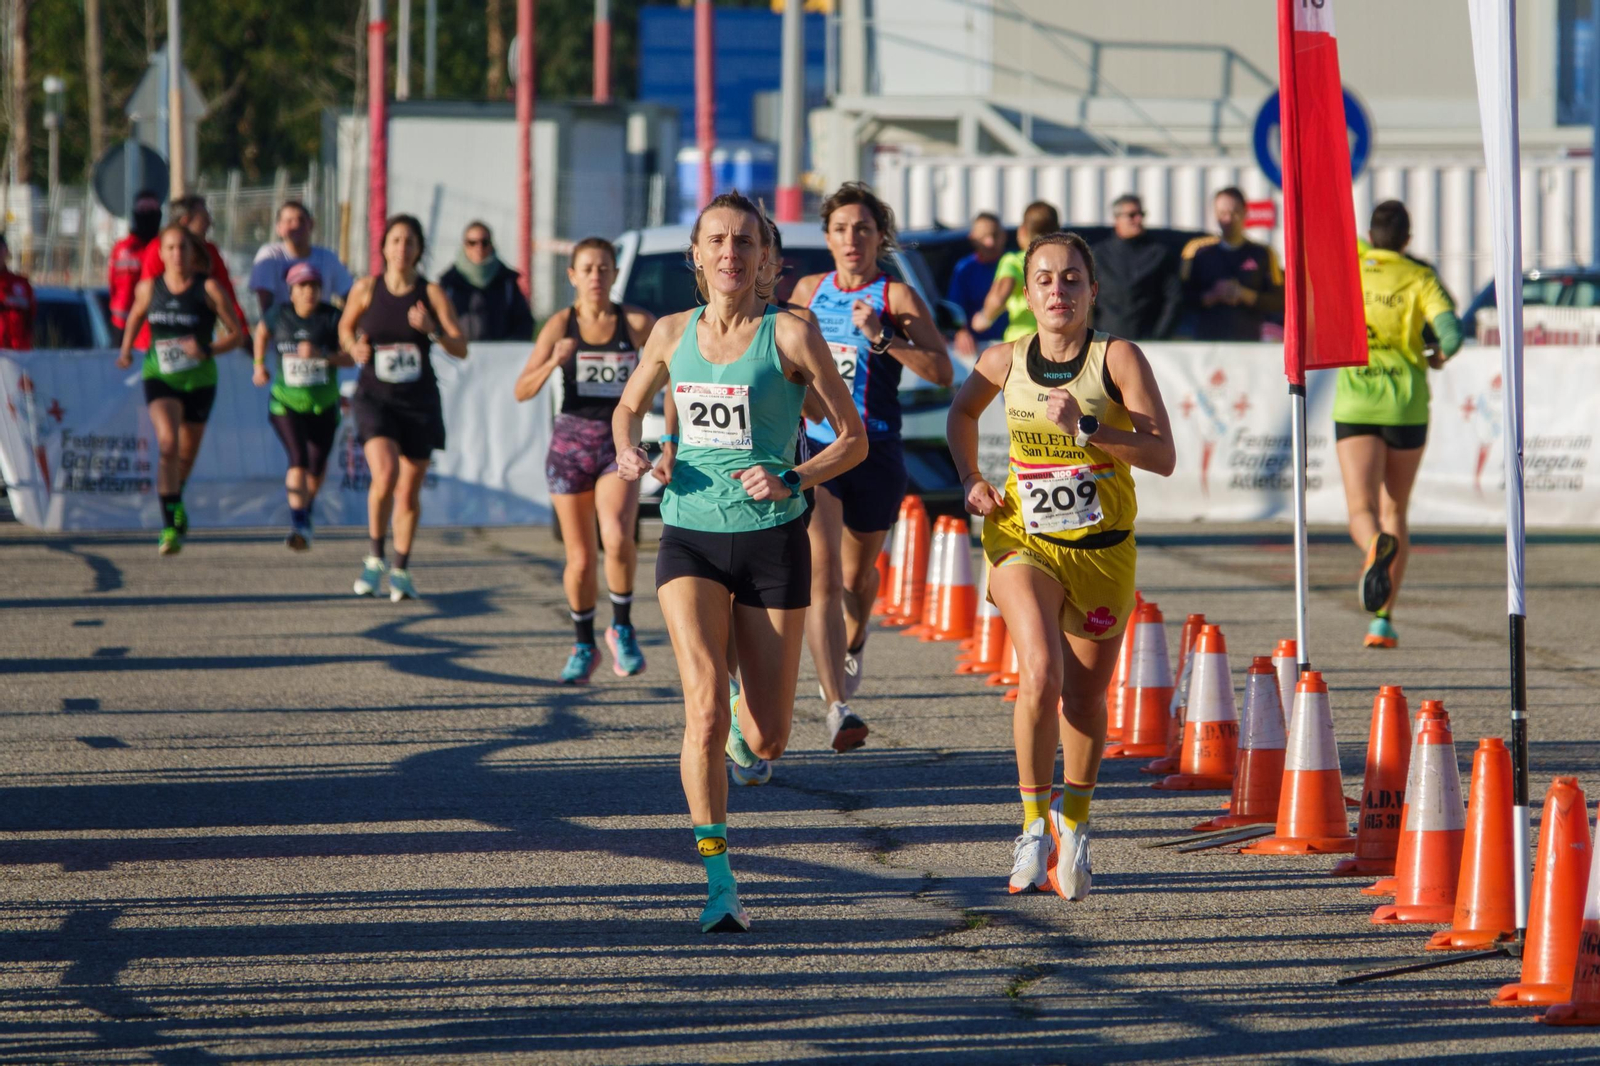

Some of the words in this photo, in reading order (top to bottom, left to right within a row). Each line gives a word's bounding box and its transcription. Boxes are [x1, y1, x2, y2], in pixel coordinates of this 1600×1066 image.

[586, 366, 629, 383] 203
[689, 401, 746, 430] 201
[1011, 429, 1079, 447] ATHLETI
[1021, 445, 1042, 457] San
[1045, 446, 1085, 459] Lázaro
[1030, 480, 1097, 514] 209
